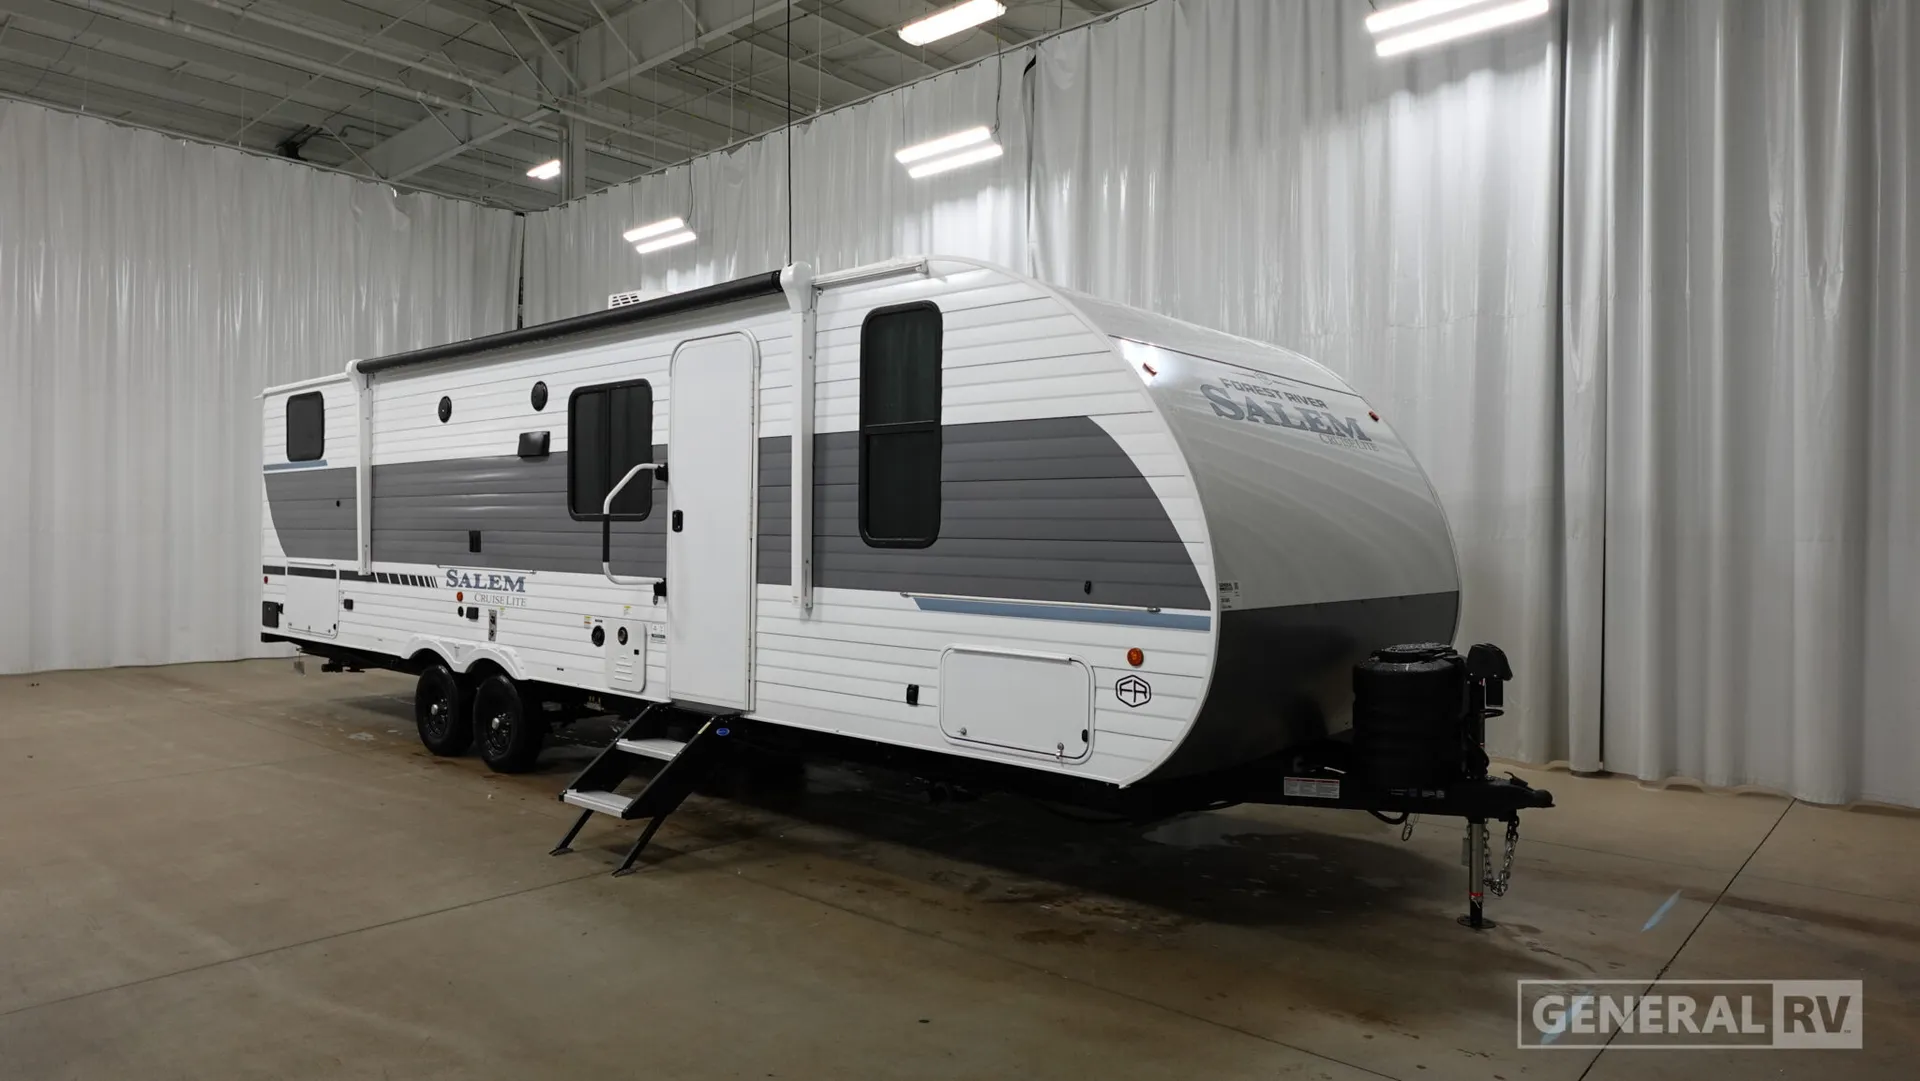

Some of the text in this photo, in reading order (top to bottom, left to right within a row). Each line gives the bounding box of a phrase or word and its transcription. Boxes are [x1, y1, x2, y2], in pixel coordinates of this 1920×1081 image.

[1220, 378, 1328, 408] FOREST RIVER
[1200, 383, 1373, 442] SALEM
[446, 569, 526, 593] SALEM
